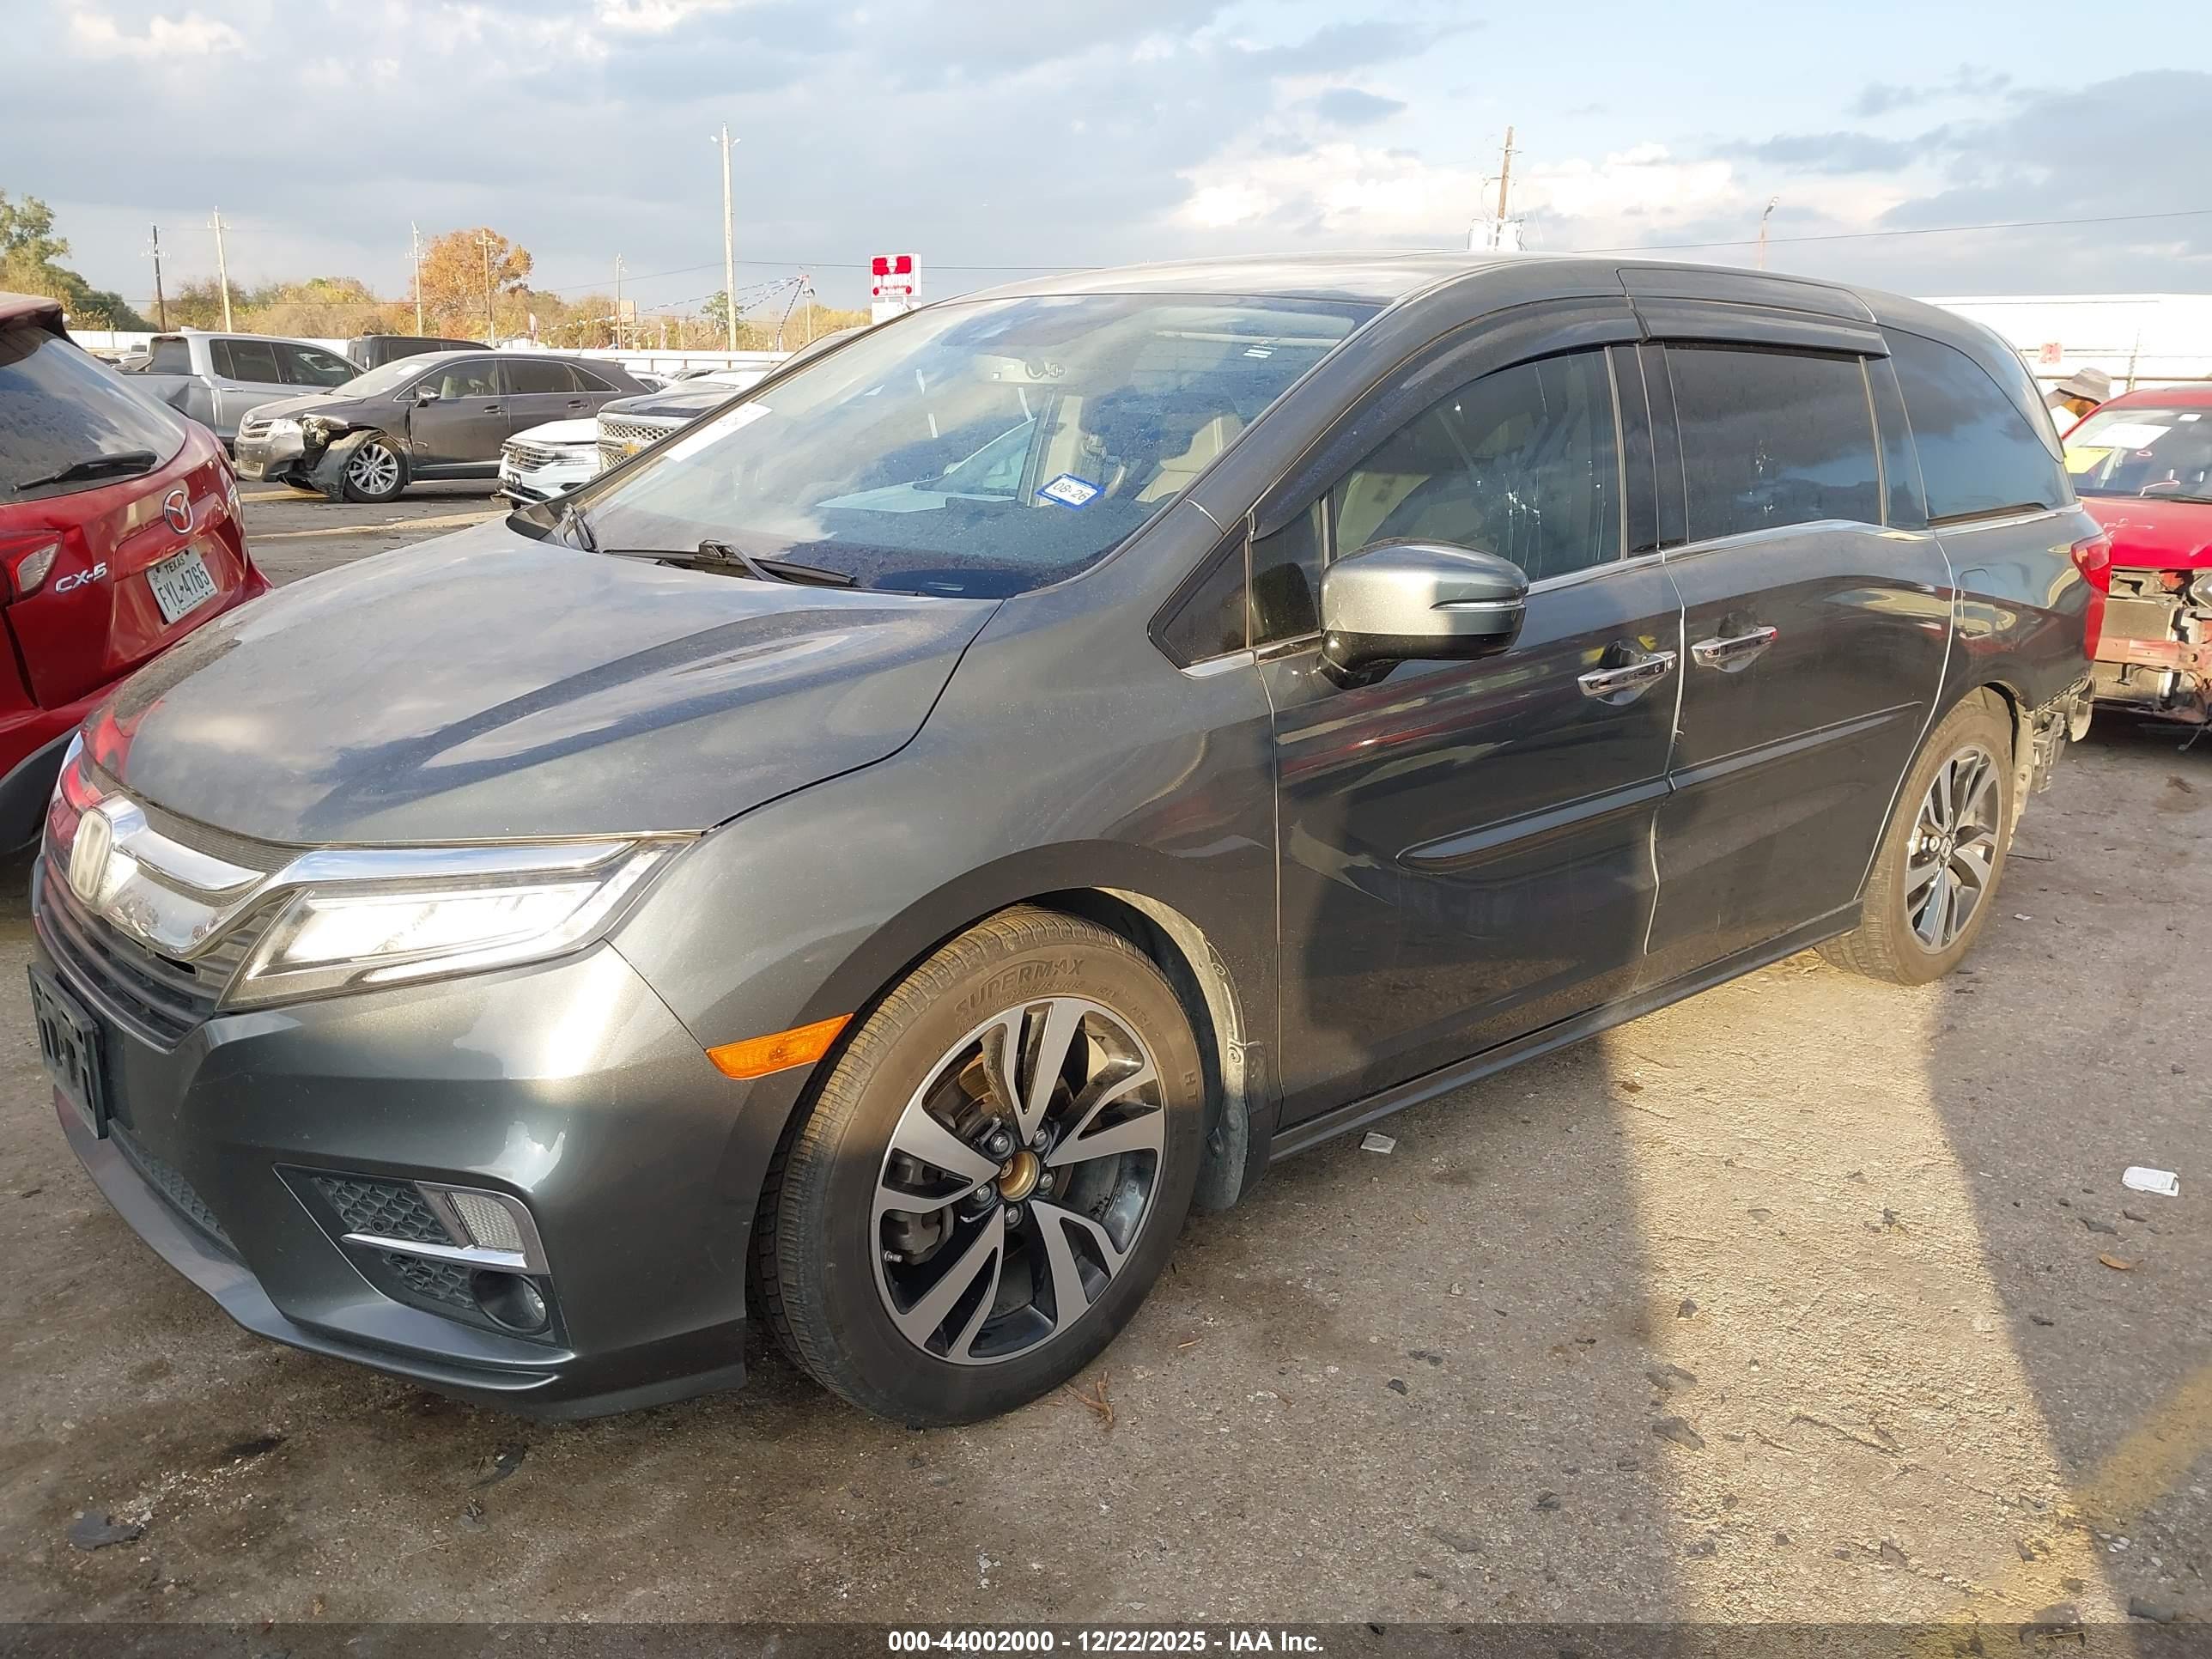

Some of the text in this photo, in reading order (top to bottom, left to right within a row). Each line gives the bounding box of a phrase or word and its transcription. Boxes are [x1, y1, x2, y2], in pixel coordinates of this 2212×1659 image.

[56, 562, 107, 592] CX-5
[164, 555, 185, 574] TEXAS
[954, 959, 1085, 1018] SUPERMAX
